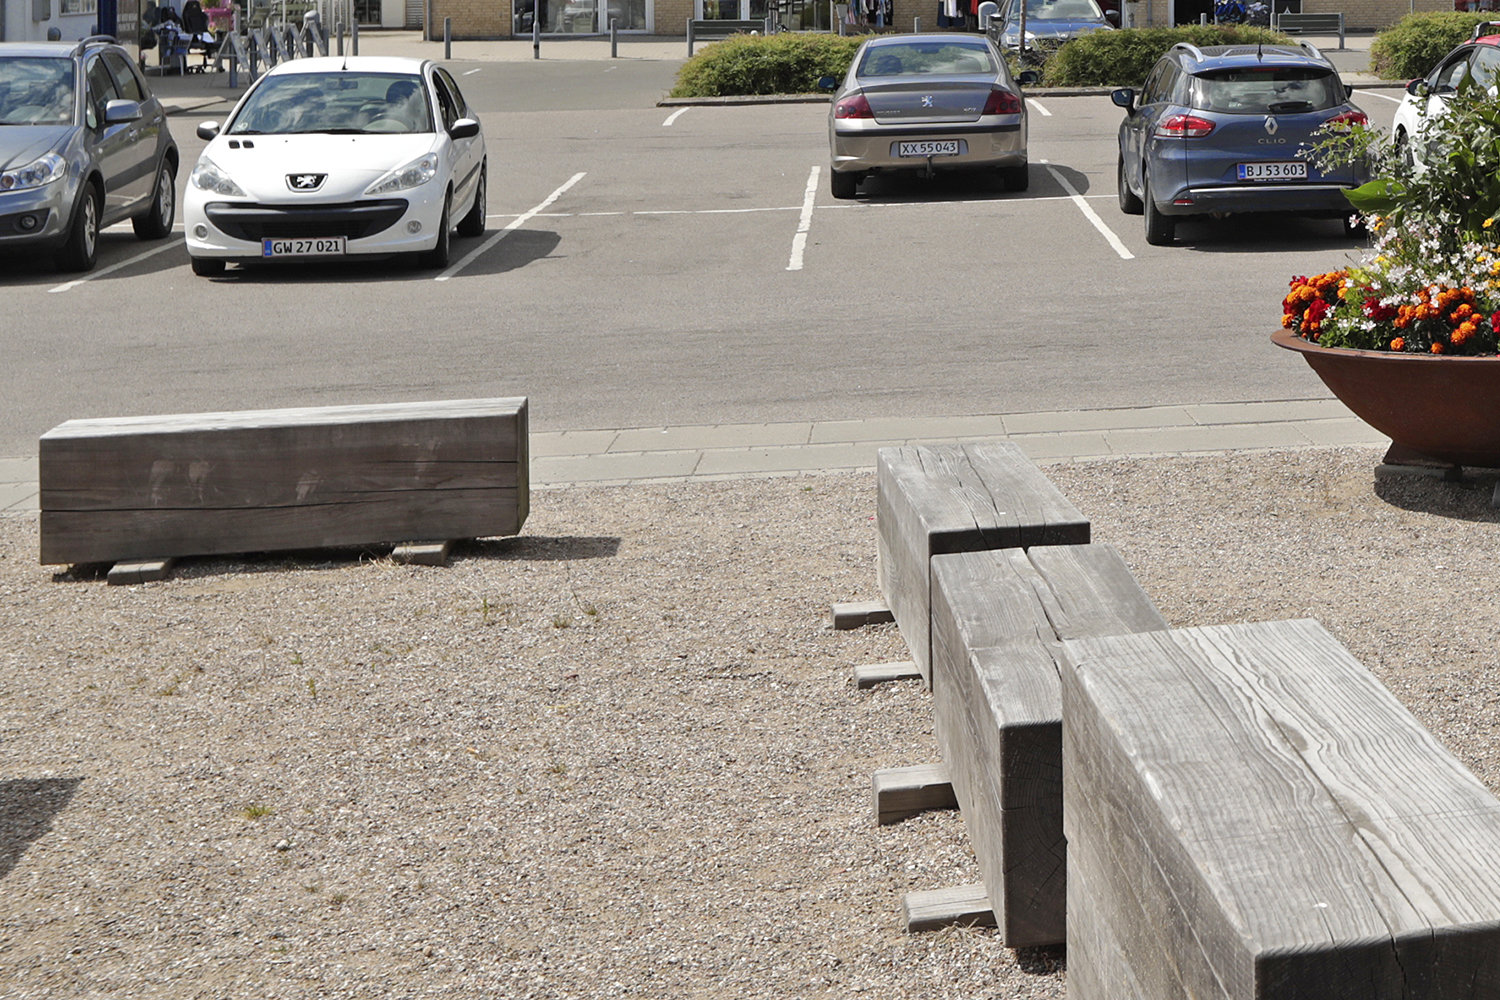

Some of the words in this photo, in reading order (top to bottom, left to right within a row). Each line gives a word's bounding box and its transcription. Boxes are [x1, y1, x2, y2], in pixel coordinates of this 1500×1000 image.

[902, 144, 918, 154] XX
[920, 143, 934, 153] 55
[935, 142, 956, 152] 043
[1246, 165, 1262, 176] BJ
[1265, 165, 1280, 176] 53
[1283, 164, 1305, 175] 603
[273, 242, 293, 254] GW
[296, 241, 313, 253] 27
[316, 241, 340, 252] 021
